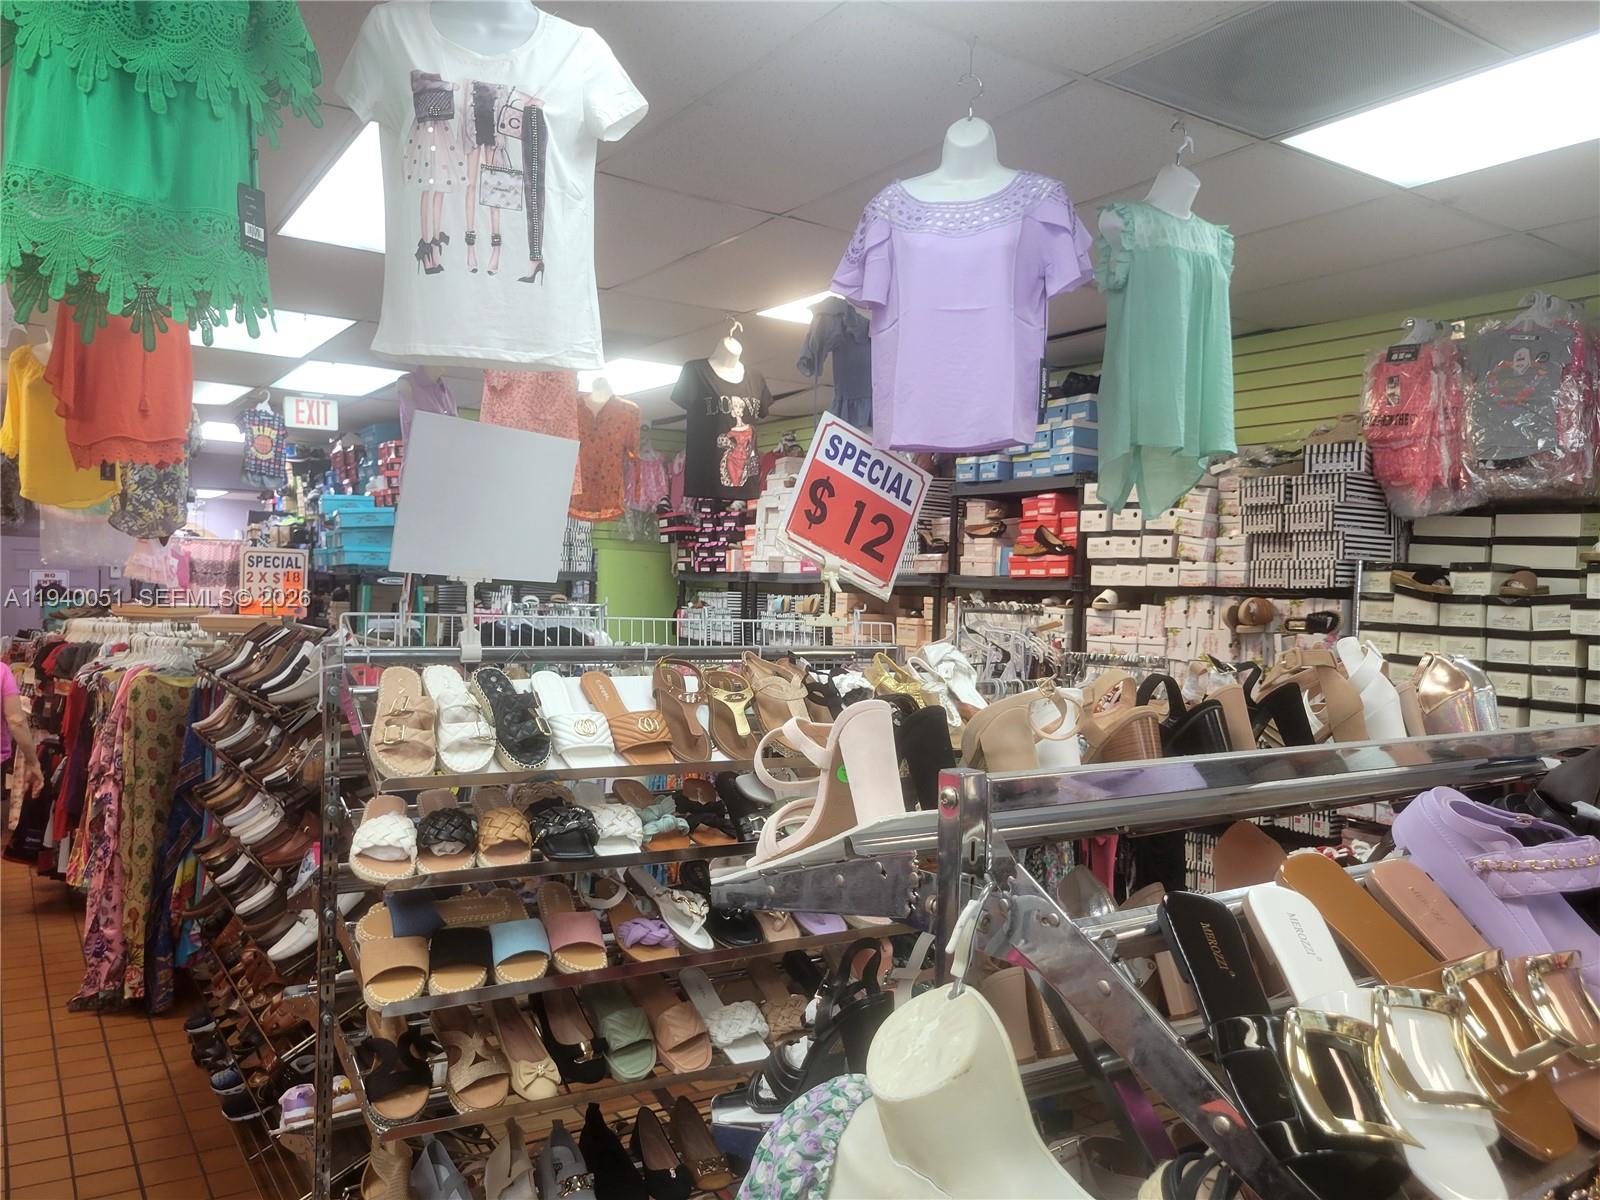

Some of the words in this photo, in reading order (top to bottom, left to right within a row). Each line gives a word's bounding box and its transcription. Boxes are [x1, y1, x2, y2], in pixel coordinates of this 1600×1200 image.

[294, 398, 330, 426] EXIT
[825, 434, 913, 507] SPECIAL
[247, 555, 302, 569] SPECIAL
[246, 571, 254, 583] 2
